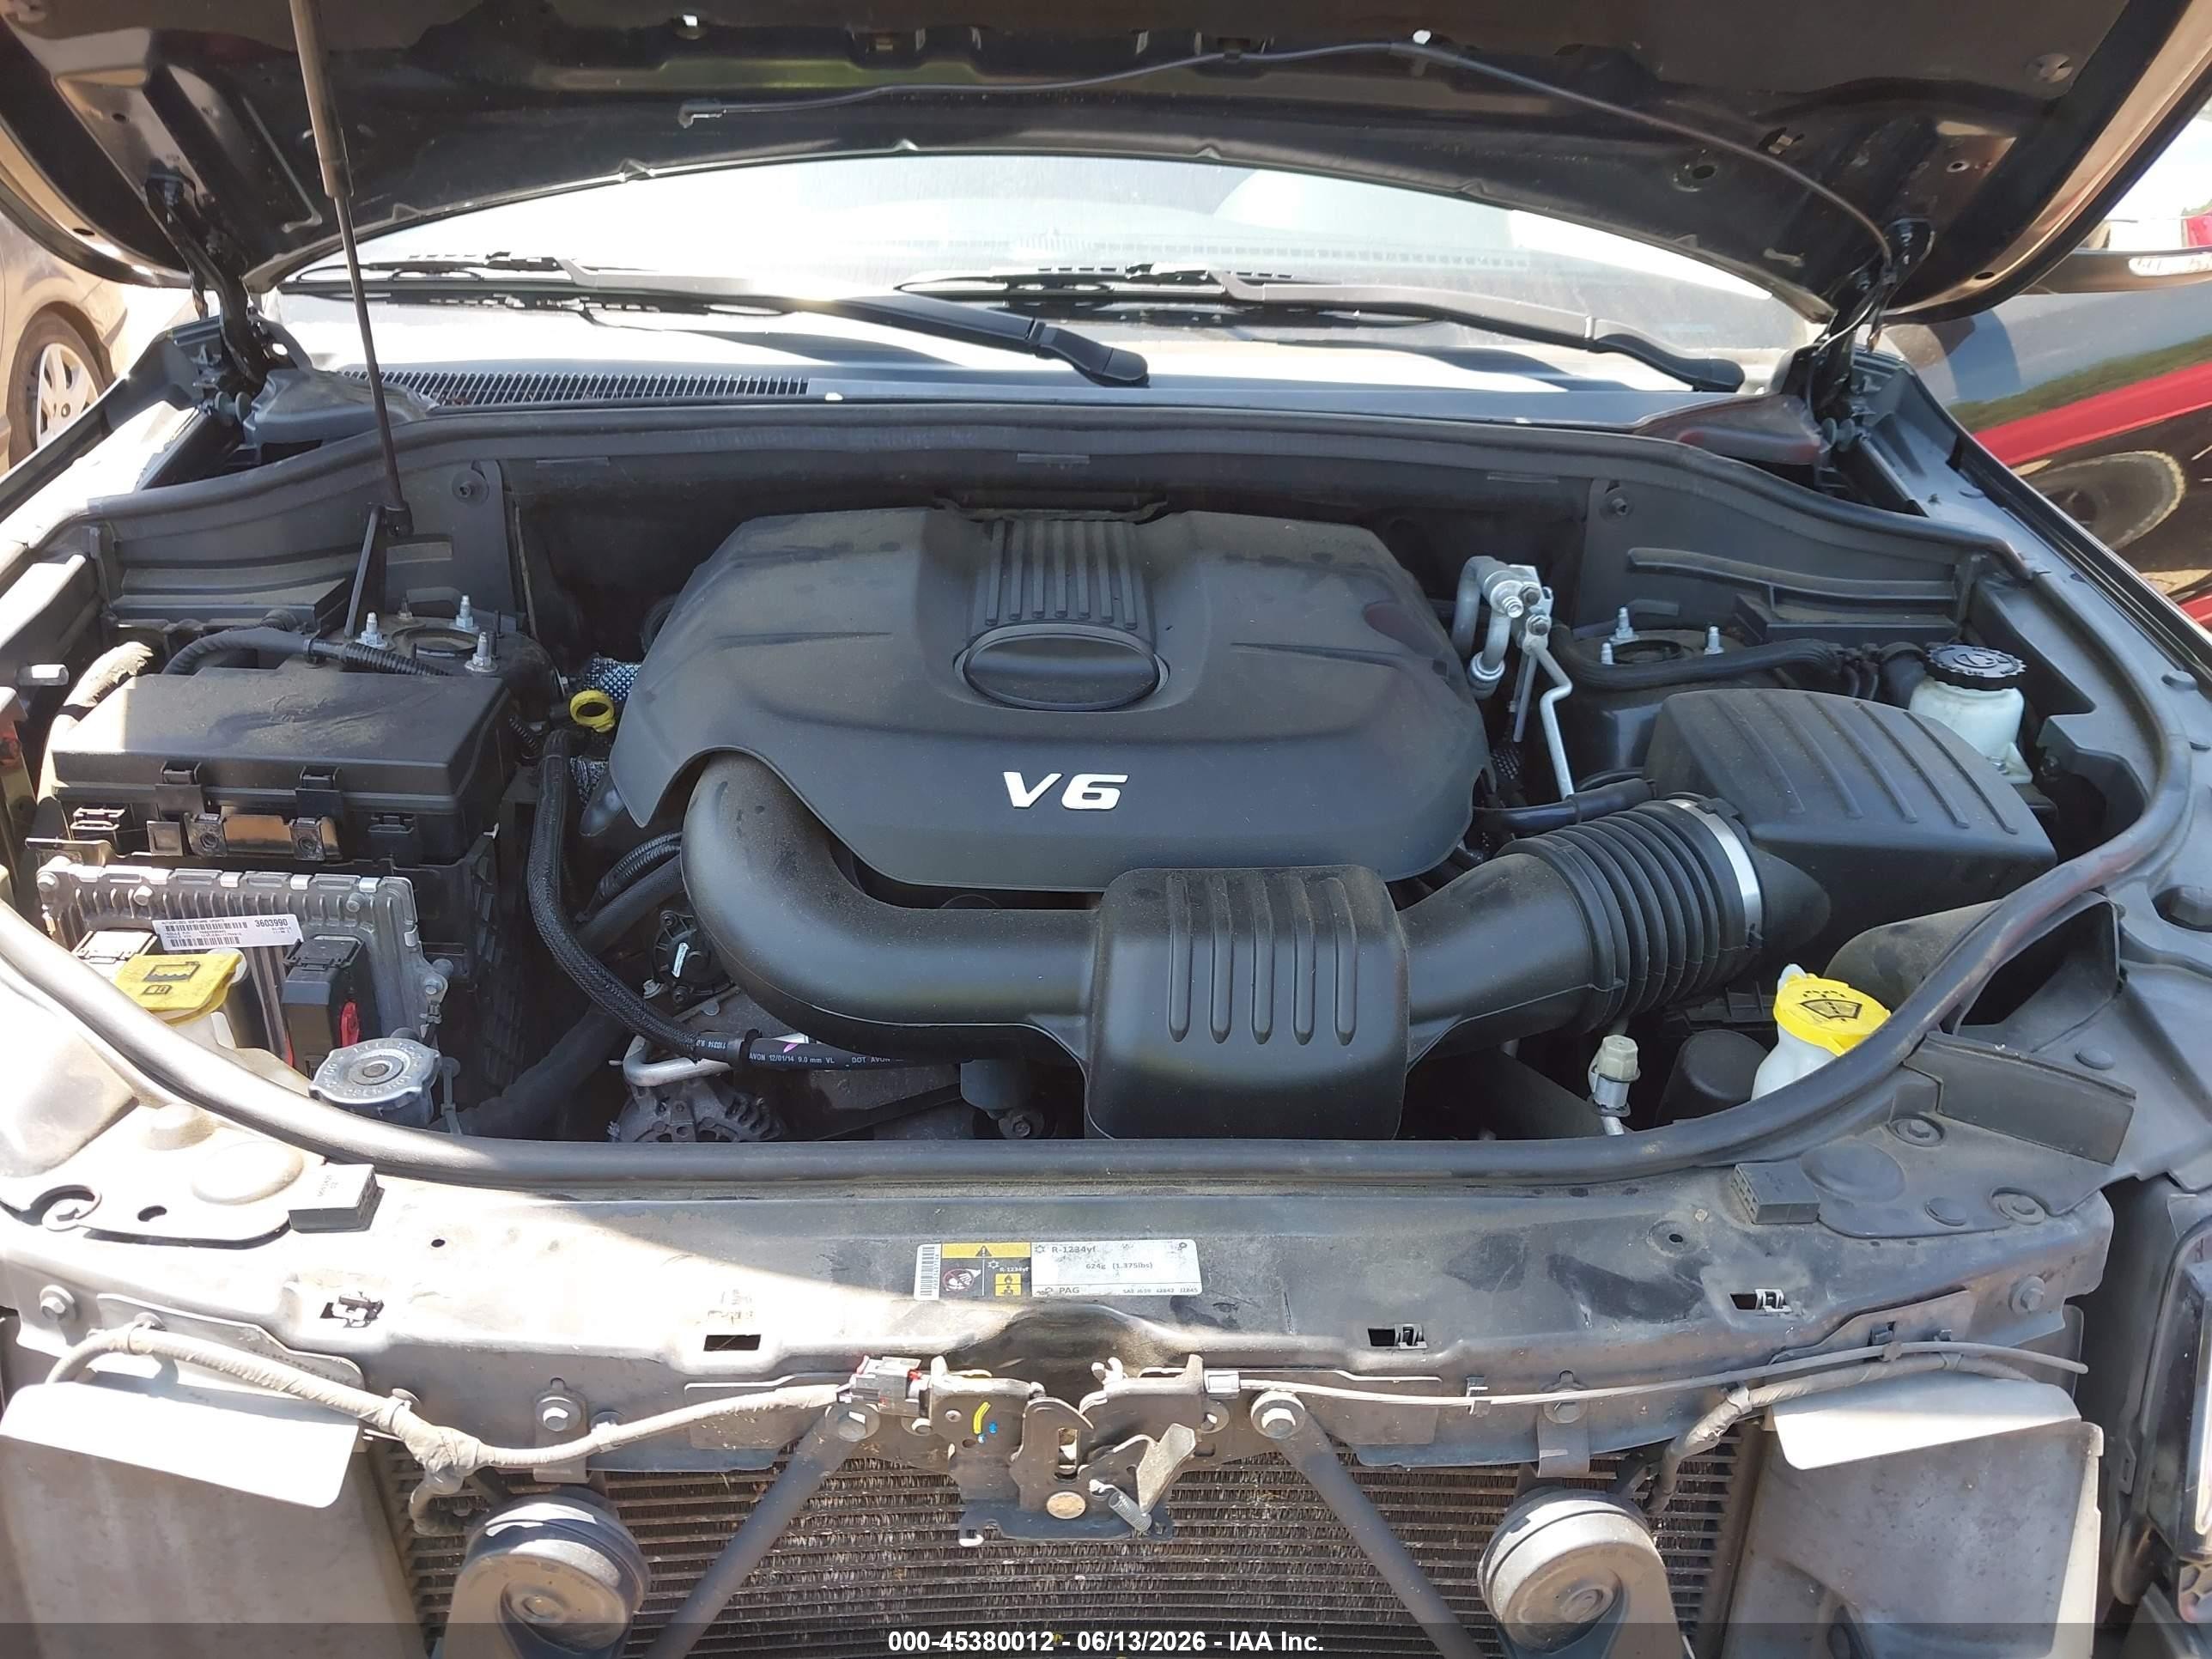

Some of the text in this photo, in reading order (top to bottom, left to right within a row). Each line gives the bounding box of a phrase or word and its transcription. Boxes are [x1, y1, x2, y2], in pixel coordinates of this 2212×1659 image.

[1002, 771, 1128, 811] V6
[254, 918, 289, 927] 3603990
[749, 1052, 766, 1061] AVON
[769, 1054, 795, 1063] 12/01/14
[1052, 1245, 1097, 1255] R-1234yf
